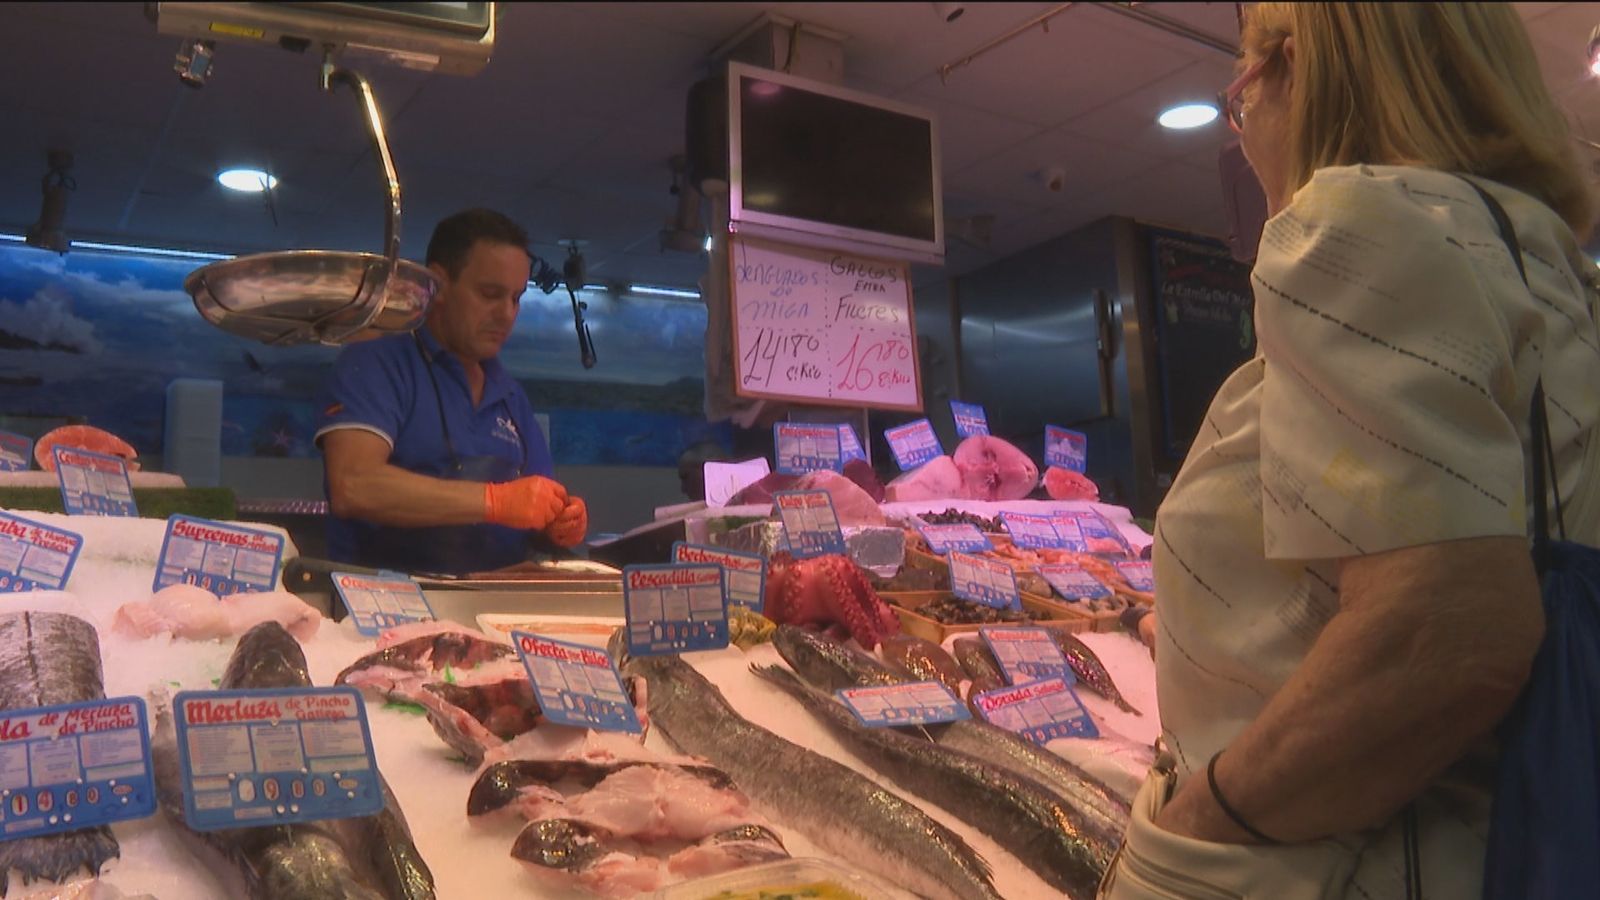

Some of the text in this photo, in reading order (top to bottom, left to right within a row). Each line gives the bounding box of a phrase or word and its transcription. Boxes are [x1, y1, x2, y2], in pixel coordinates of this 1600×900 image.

[172, 519, 248, 546] Supremas
[630, 568, 696, 590] Pescadilla
[521, 636, 568, 660] Oferta
[186, 695, 350, 724] Merluza de Pincho
[982, 688, 1031, 711] Dorada
[39, 712, 60, 726] de
[64, 703, 132, 722] Merluza
[58, 716, 135, 736] de Pincho
